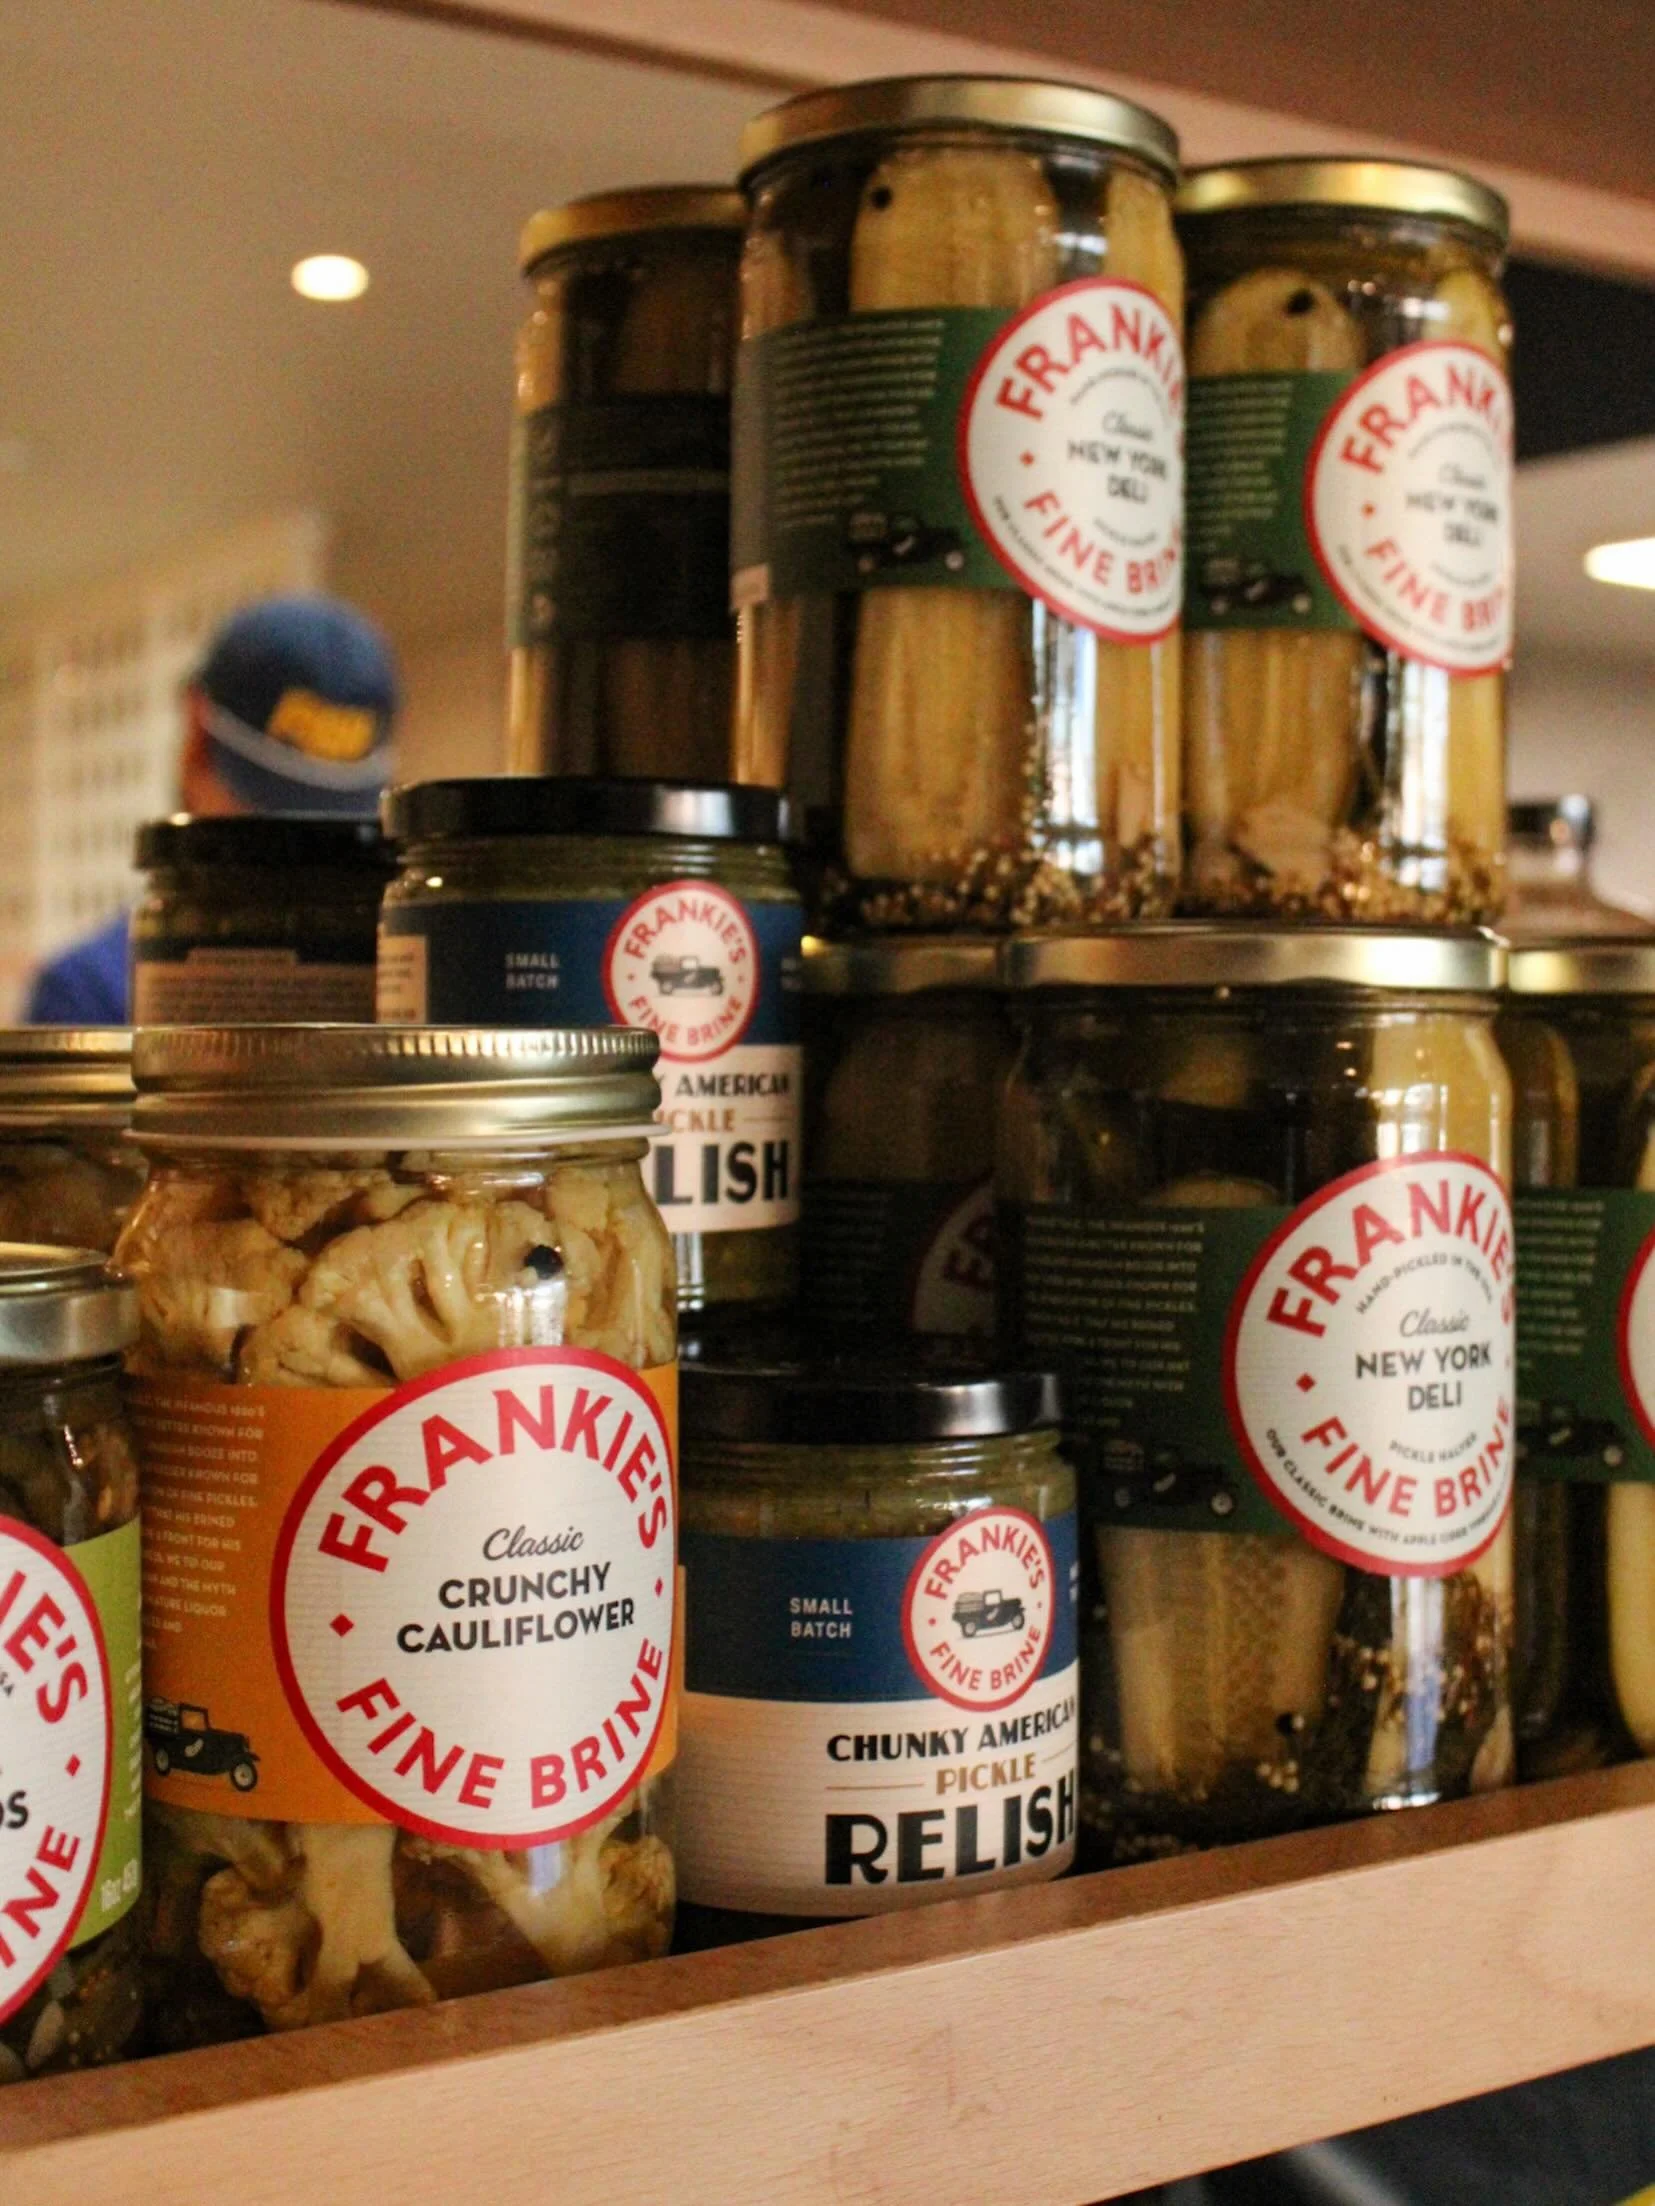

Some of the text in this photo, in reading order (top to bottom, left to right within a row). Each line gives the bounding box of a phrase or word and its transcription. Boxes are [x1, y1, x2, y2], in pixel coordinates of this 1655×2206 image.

[1023, 490, 1115, 587] FINE
[624, 899, 746, 964] FRANKIE'S
[629, 995, 743, 1047] FINE BRINE
[654, 1138, 790, 1206] LISH
[1399, 1307, 1470, 1338] Classic
[1355, 1340, 1493, 1380] NEW YORK
[1407, 1380, 1463, 1412] DELI
[317, 1384, 669, 1574] FRANKIE'S
[1300, 1415, 1418, 1518] FINE
[482, 1524, 585, 1562] Classic
[923, 1524, 1046, 1601] FRANKIE'S
[437, 1561, 612, 1610] CRUNCHY
[789, 1597, 854, 1616] SMALL
[396, 1597, 635, 1654] CAULIFLOWER
[790, 1621, 853, 1639] BATCH
[930, 1625, 1042, 1691] FINE BRINE
[336, 1637, 663, 1810] FINE BRINE
[826, 1726, 969, 1762] CHUNKY
[935, 1752, 1037, 1796] PICKLE
[823, 1767, 1076, 1886] RELISH
